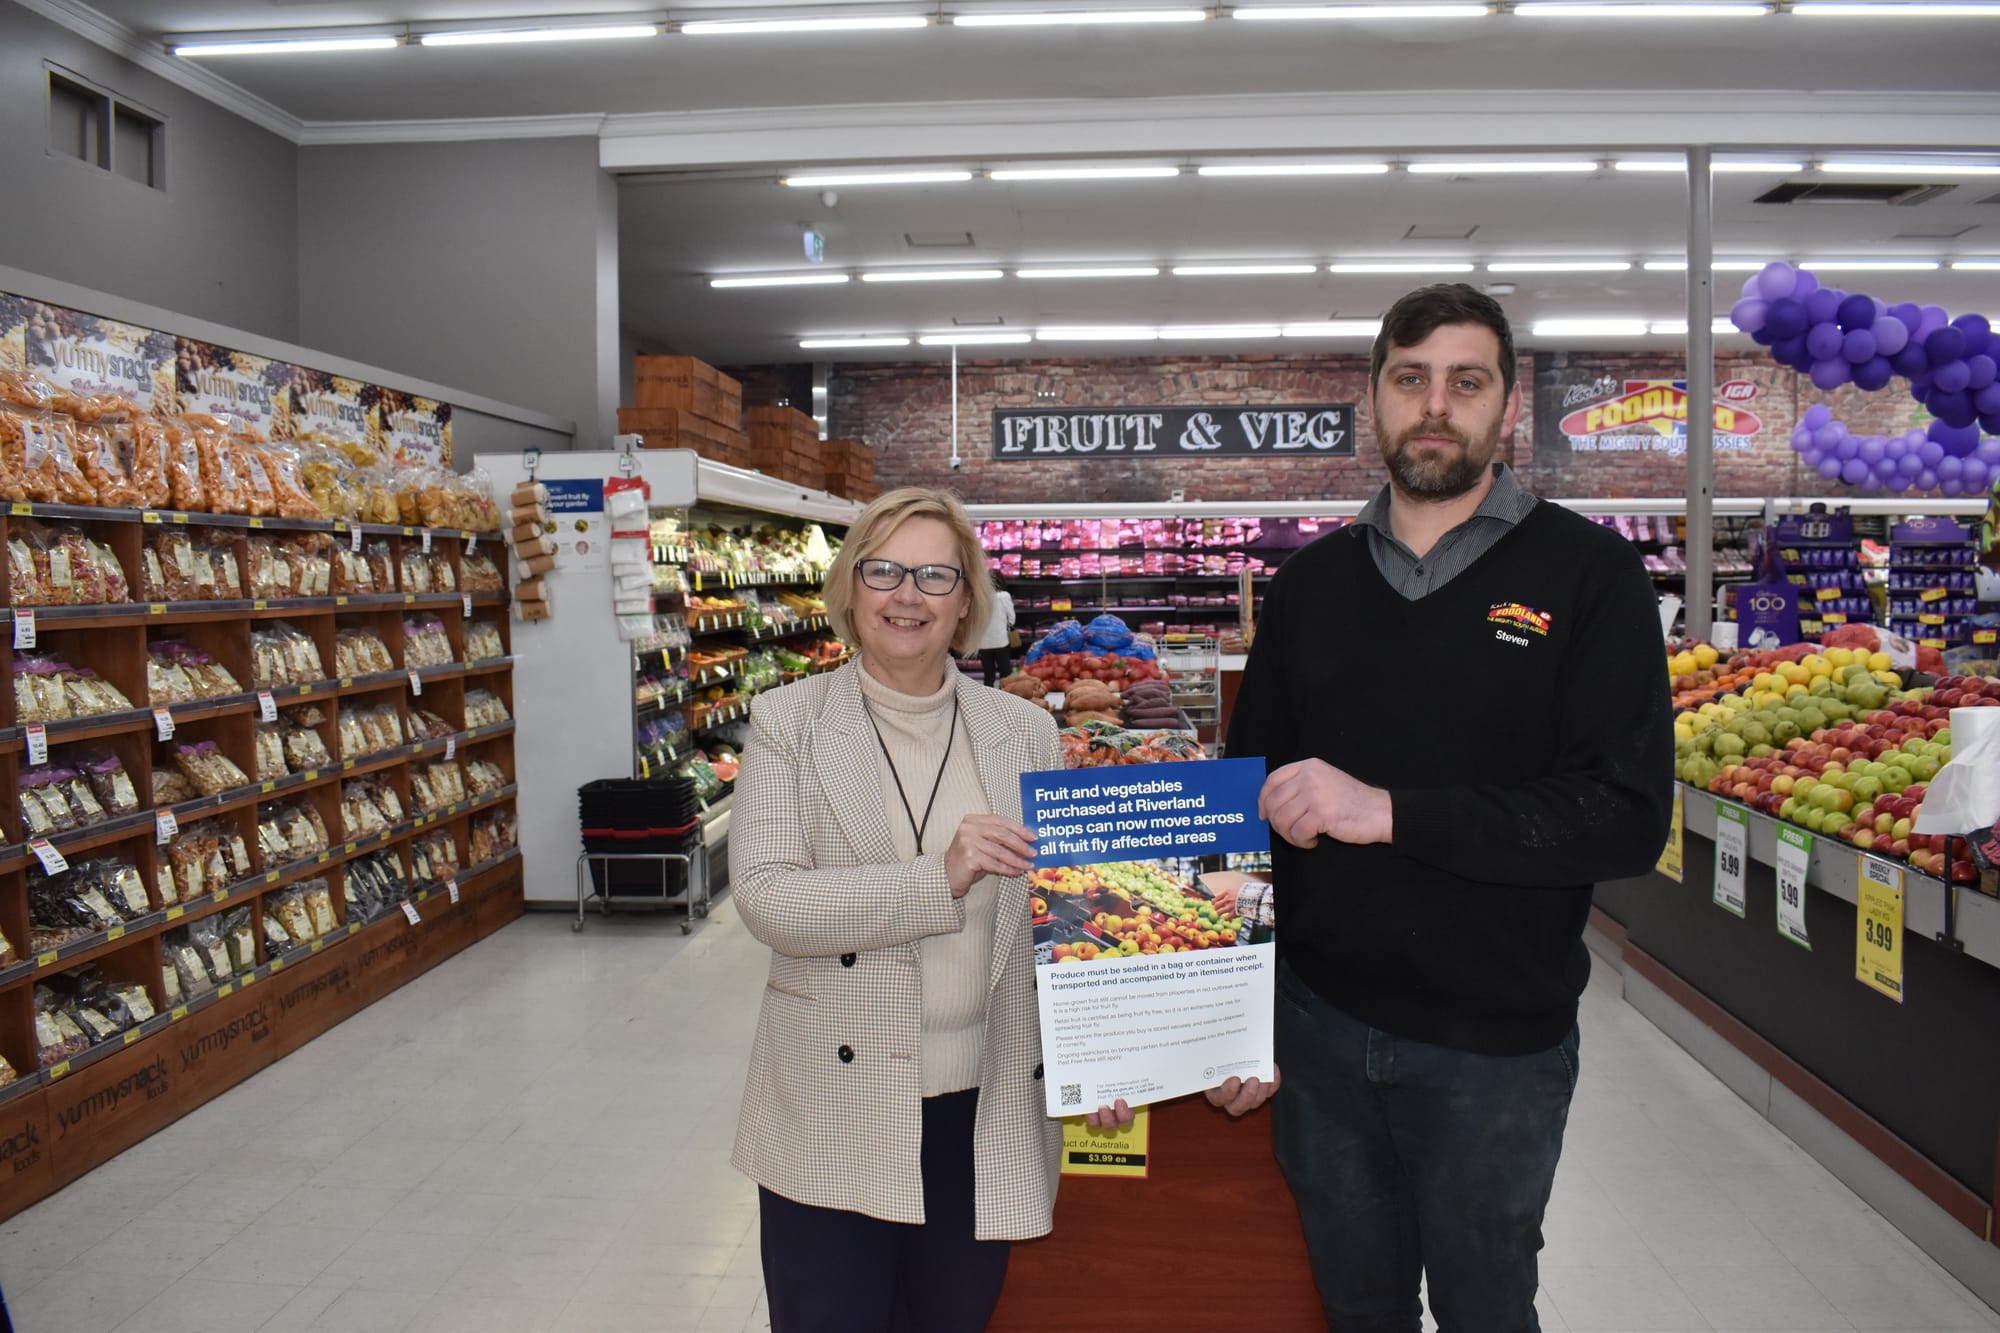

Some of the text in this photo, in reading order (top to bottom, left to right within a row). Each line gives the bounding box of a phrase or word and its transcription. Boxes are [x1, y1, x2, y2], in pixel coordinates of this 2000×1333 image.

[1725, 384, 1754, 398] IGA
[1586, 390, 1735, 432] FOODLAD
[1001, 410, 1345, 452] FRUIT & VEG
[1569, 435, 1750, 450] THE MIGHTY SOUT USSIES
[1749, 597, 1785, 611] 100
[1496, 606, 1542, 627] FOODLAND
[1495, 629, 1529, 647] Steven
[1035, 780, 1183, 802] Fruit and vegetables
[1037, 794, 1205, 822] purchased at Riverland
[1722, 806, 1740, 820] FRESH
[1038, 812, 1244, 838] shops can now move across
[1040, 831, 1217, 855] all fruit fly affected areas
[1782, 828, 1804, 846] FRESH
[1721, 851, 1739, 877] 5.99
[1870, 861, 1890, 875] WEEKLY
[1869, 870, 1890, 886] SPECIAL
[1781, 879, 1798, 909] 5.99
[1866, 917, 1892, 952] 3.99
[1051, 970, 1085, 980] Produce
[1087, 968, 1108, 977] must
[1110, 967, 1120, 975] be
[1122, 964, 1149, 974] sealed
[1168, 961, 1183, 970] bag
[1196, 956, 1234, 967] container
[1235, 953, 1257, 962] when
[1052, 979, 1100, 991] transported
[1102, 977, 1118, 986] and
[1119, 972, 1175, 984] accompanied
[1176, 971, 1186, 980] by
[1200, 966, 1234, 977] itemised
[1235, 962, 1264, 972] receipt.
[179, 1001, 269, 1072] yummysnack
[57, 1053, 168, 1140] yummysnack
[1063, 1139, 1130, 1150] uct of Australia
[1088, 1153, 1127, 1164] $3.99 ea
